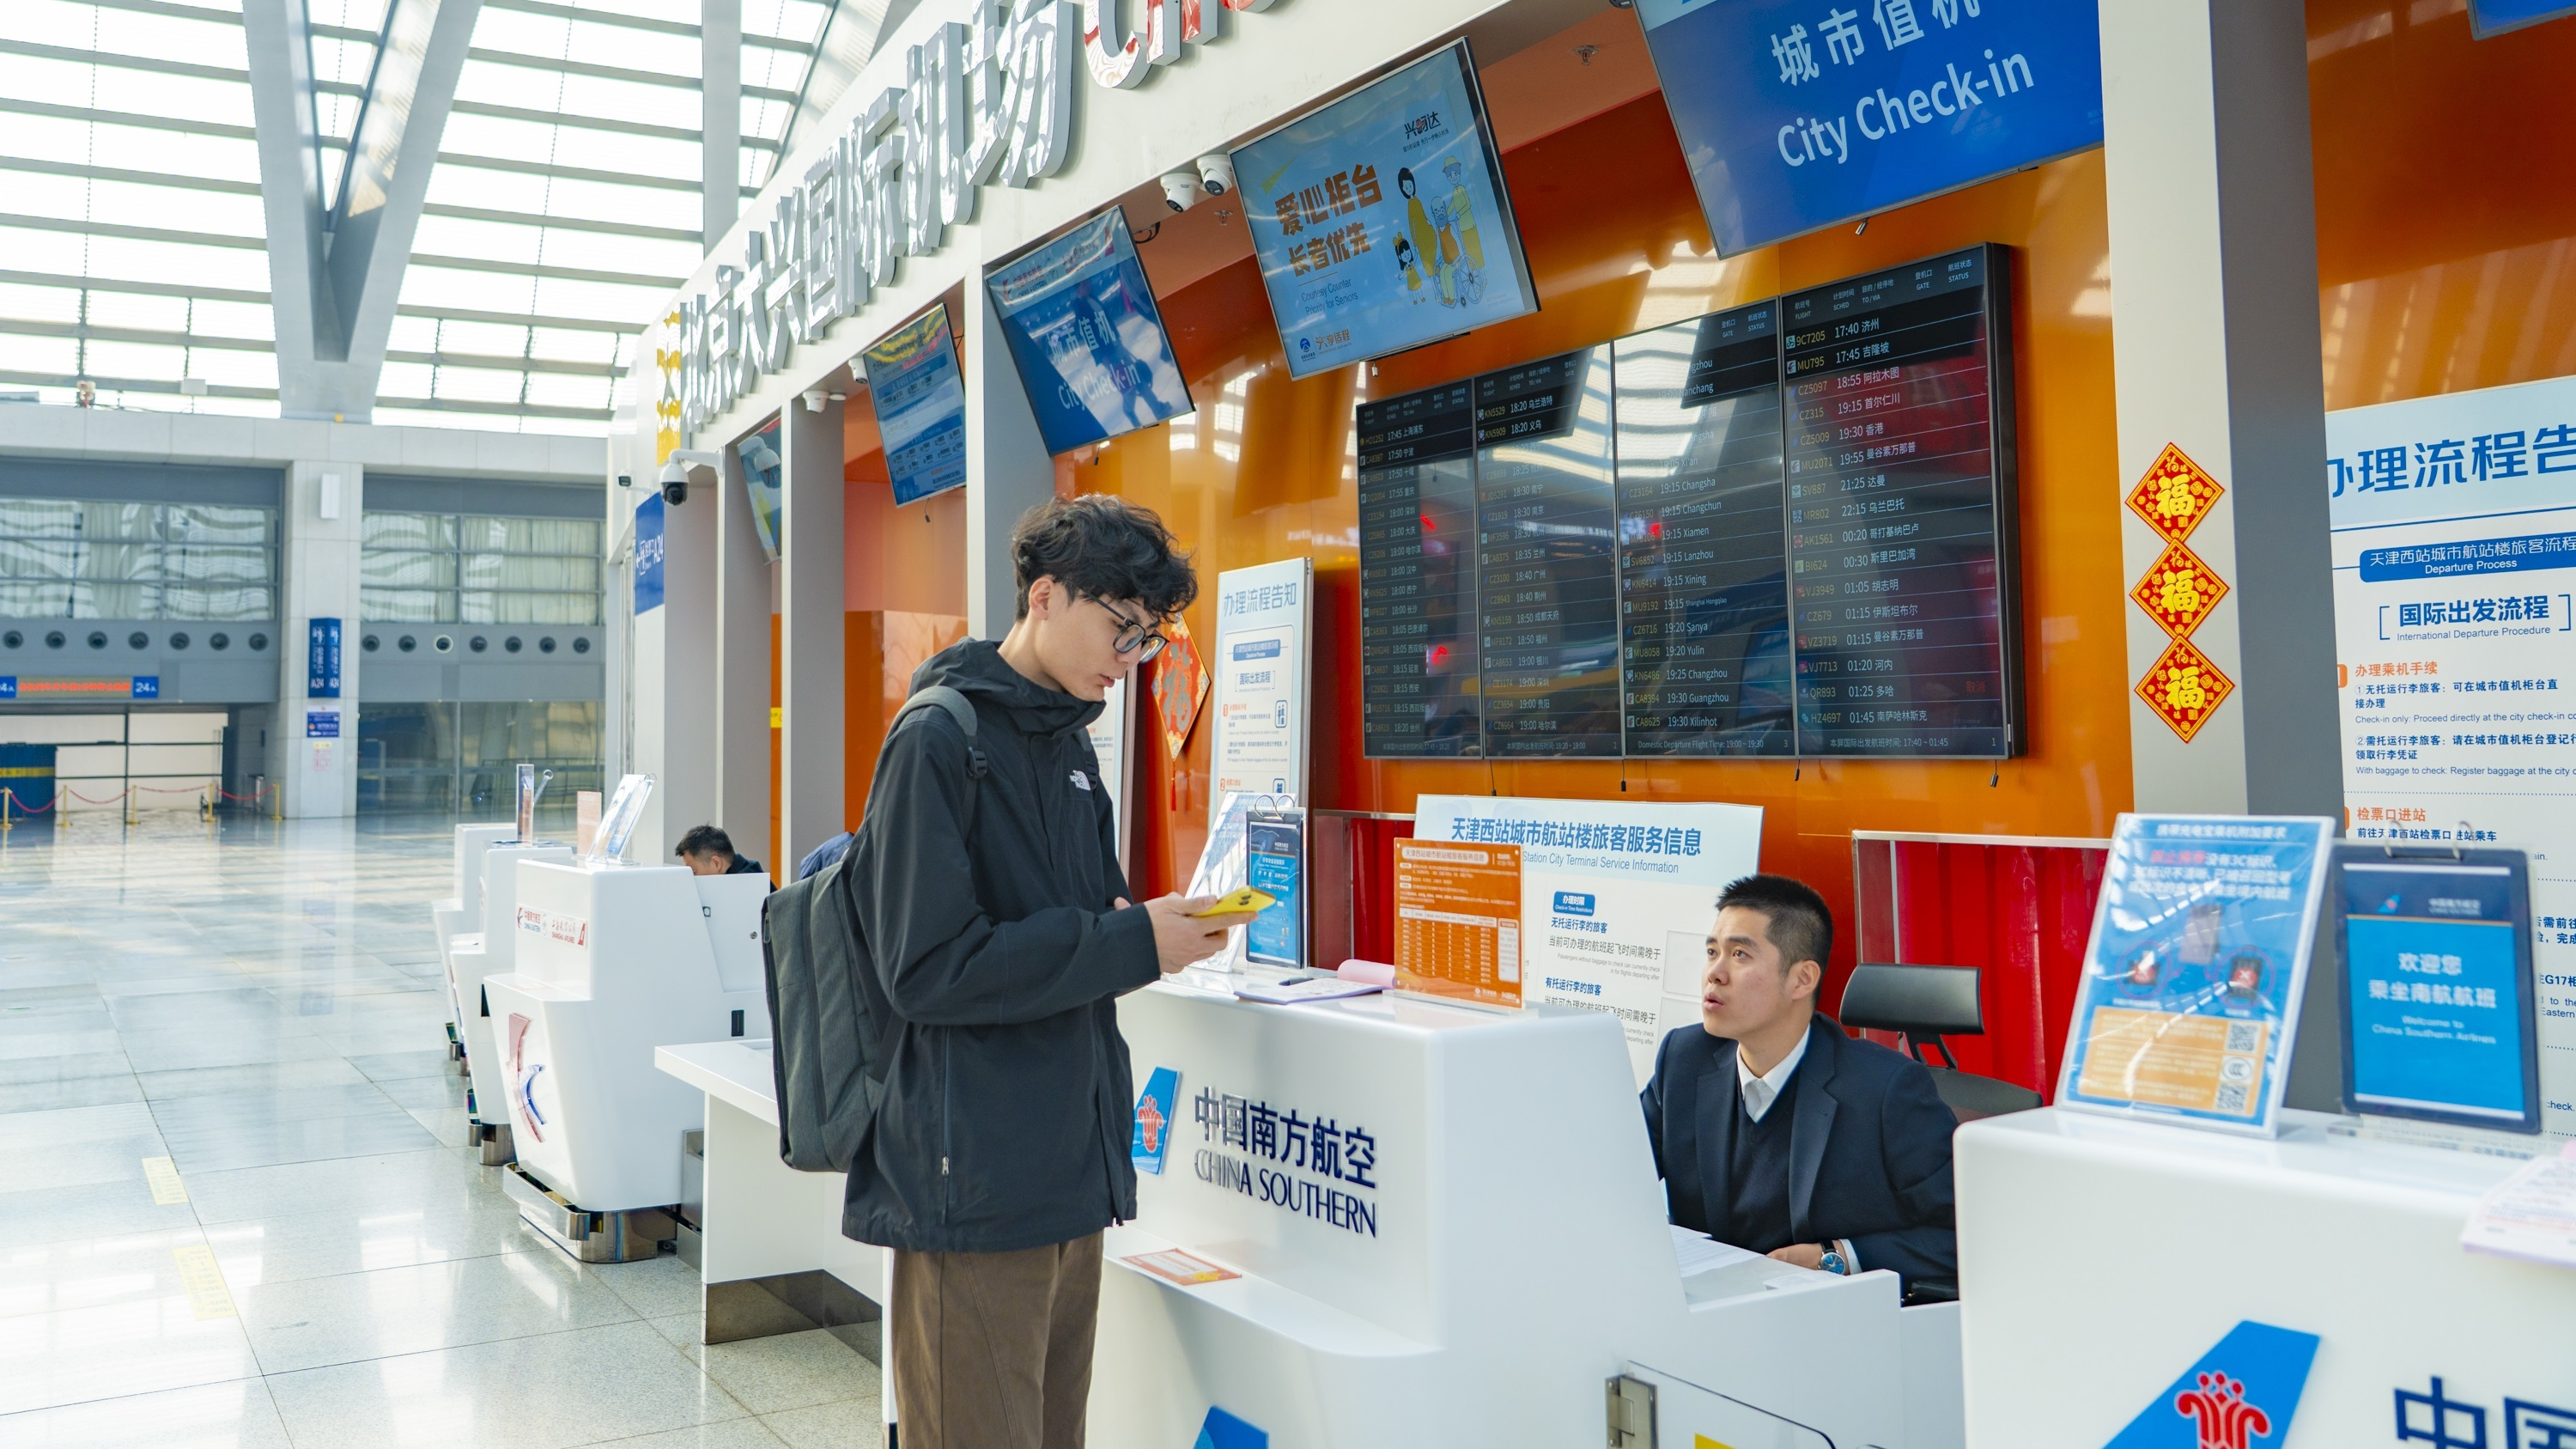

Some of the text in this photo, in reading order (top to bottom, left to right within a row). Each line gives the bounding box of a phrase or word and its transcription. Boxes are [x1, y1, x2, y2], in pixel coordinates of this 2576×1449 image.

[1777, 48, 2034, 167] City Check-in
[1274, 164, 1383, 235] 爱心柜台
[1287, 222, 1371, 277] 长者优先
[1916, 269, 1932, 280] 登机口
[1948, 259, 1971, 271] 航班状态
[1301, 277, 1352, 302] Courtesy Counter
[1795, 311, 1811, 320] FLIGHT
[1917, 282, 1929, 290] GATE
[1948, 272, 1969, 283] STATUS
[1305, 301, 1325, 315] Priority
[1335, 291, 1358, 307] Seniors
[1048, 310, 1115, 363] 城市值机
[1796, 318, 1879, 346] 9C7205 17:40 济州
[1797, 342, 1889, 371] MU795 17:45 吉隆坡
[1058, 361, 1141, 411] City Check-in
[1799, 367, 1899, 396] CZ5097 18:55 阿拉木图
[1510, 400, 1527, 414] 18:20
[1528, 395, 1552, 409] 乌兰浩特
[1511, 423, 1528, 435] 18:20
[1529, 420, 1541, 430] 义乌
[1801, 423, 1883, 447] CZ5009 19:30 香港
[1801, 441, 1916, 472] MU2071 19:55 曼谷素万那普
[1661, 478, 1715, 494] 19:15 Changsha
[2155, 473, 2196, 519] 福
[2370, 536, 2576, 567] 天津西站城市航站楼旅客流程
[2425, 559, 2517, 575] Departure Process
[1631, 575, 1707, 589] KN6414 19:15 Xining
[1806, 579, 1899, 597] VJ3949 01:05 胡志明
[2160, 569, 2200, 613] 福
[1224, 582, 1297, 617] 办理流程告知
[2399, 594, 2549, 627] 国际出发流程
[1633, 622, 1708, 635] CZ6716 19:20 Sanya
[1808, 629, 1923, 648] VZ3719 01:15 曼谷素万那普
[2397, 626, 2550, 641] International Departure Procedure
[1634, 646, 1704, 657] MU8058 19:20 Yulin
[1808, 659, 1893, 673] VJ7713 01:20 河内
[2355, 661, 2438, 677] 办理乘机手续
[1810, 685, 1894, 698] QR893 01:25 多哈
[1966, 680, 1985, 694] 取消
[2166, 667, 2205, 709] 福
[1635, 692, 1729, 705] CA8394 19:30 Guangzhou
[2355, 698, 2385, 709] 接办理
[1636, 716, 1717, 727] CA8625 19:30 Xilinhot
[1811, 710, 1927, 724] HZ4697 01:45 南萨哈林斯克
[2392, 715, 2410, 724] only:
[2451, 714, 2480, 722] directly
[2494, 713, 2506, 721] the
[2510, 713, 2524, 722] city
[2527, 712, 2565, 721] check-in
[1663, 740, 1691, 750] Departure
[1692, 740, 1707, 749] Flight
[1904, 737, 1922, 747] 17:40
[1929, 737, 1948, 747] 01:45
[2356, 750, 2417, 759] 领取行李凭证
[2376, 767, 2409, 776] baggage
[2451, 767, 2485, 776] Register
[2488, 767, 2524, 776] baggage
[2555, 767, 2569, 776] city
[2357, 807, 2426, 822] 检票口进站
[1452, 818, 1701, 855] 天津西站城市航站楼旅客服务信息
[1522, 850, 1679, 874] Station City Terminal Service Information
[1563, 895, 1585, 905] 办理时限
[1552, 917, 1607, 934] 无托运行李的旅客
[1549, 935, 1661, 959] 当前可办理的航班起飞时间需晚于
[2398, 953, 2462, 976] 欢迎您
[1546, 977, 1601, 995] 有托运行李的旅客
[2368, 979, 2497, 1008] 乘坐南航航班
[2372, 1024, 2496, 1044] China Southern Airlines
[1195, 1087, 1376, 1189] 中国南方航空
[1194, 1148, 1376, 1239] CHINA SOUTHERN
